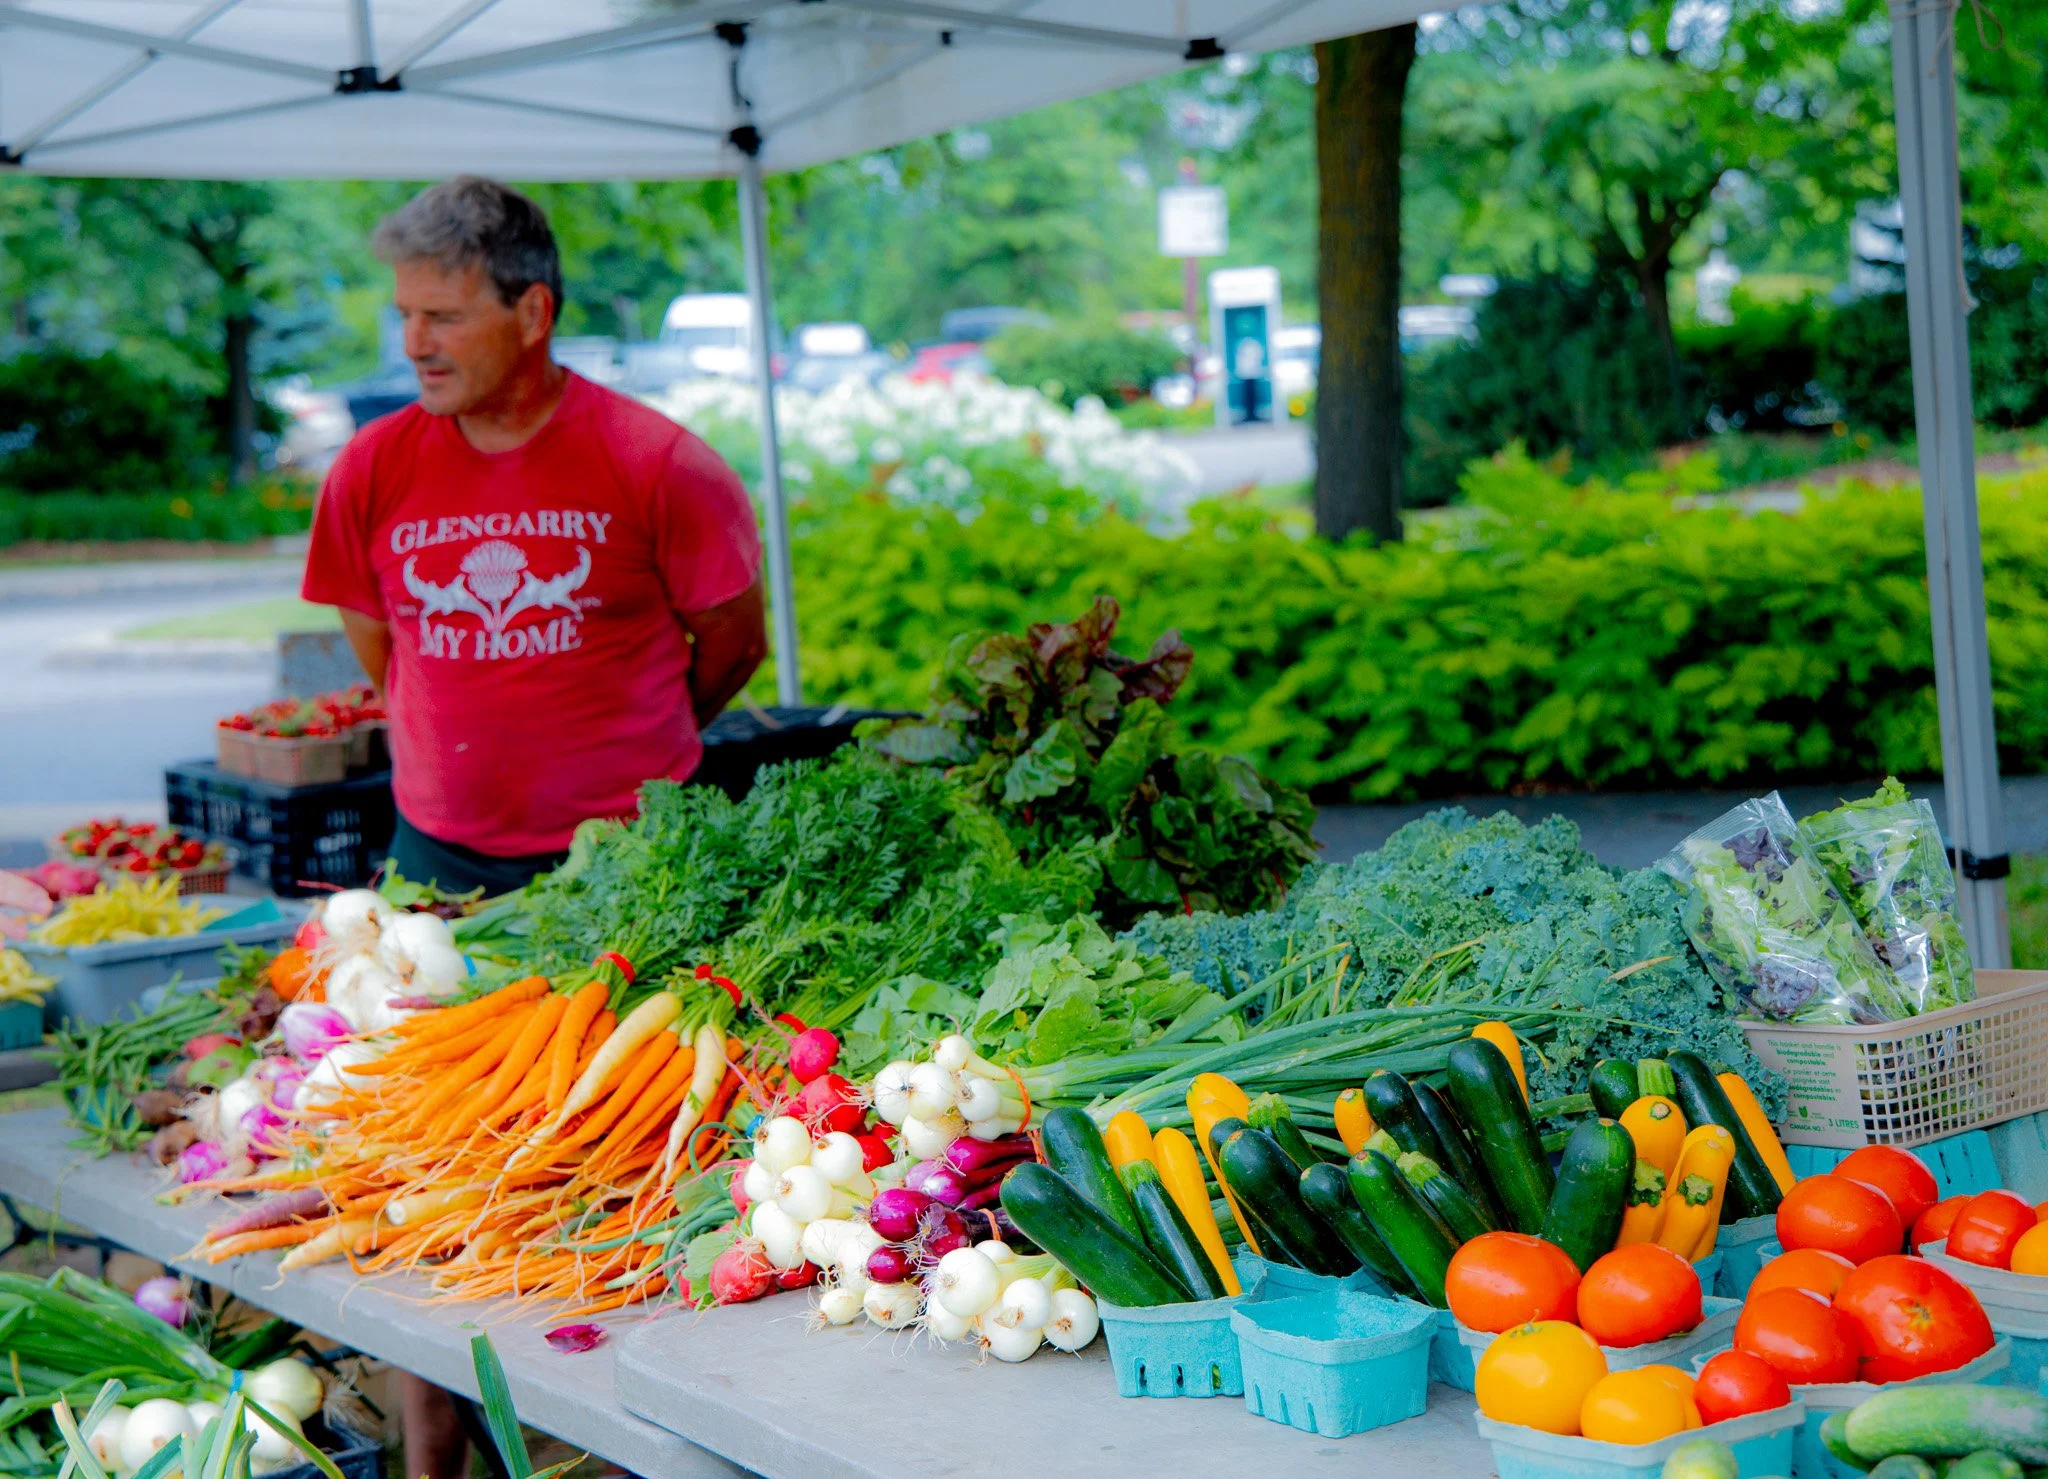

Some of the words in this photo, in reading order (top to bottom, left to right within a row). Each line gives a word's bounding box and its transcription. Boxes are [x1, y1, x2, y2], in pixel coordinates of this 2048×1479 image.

[391, 510, 612, 554] GLENGARRY
[419, 622, 467, 660] MY
[474, 615, 584, 660] HOME
[1814, 1041, 1835, 1050] handle
[1776, 1048, 1820, 1057] biodegradable
[1789, 1123, 1811, 1131] CANADA
[1828, 1118, 1833, 1127] 3
[1835, 1119, 1860, 1129] LITRES
